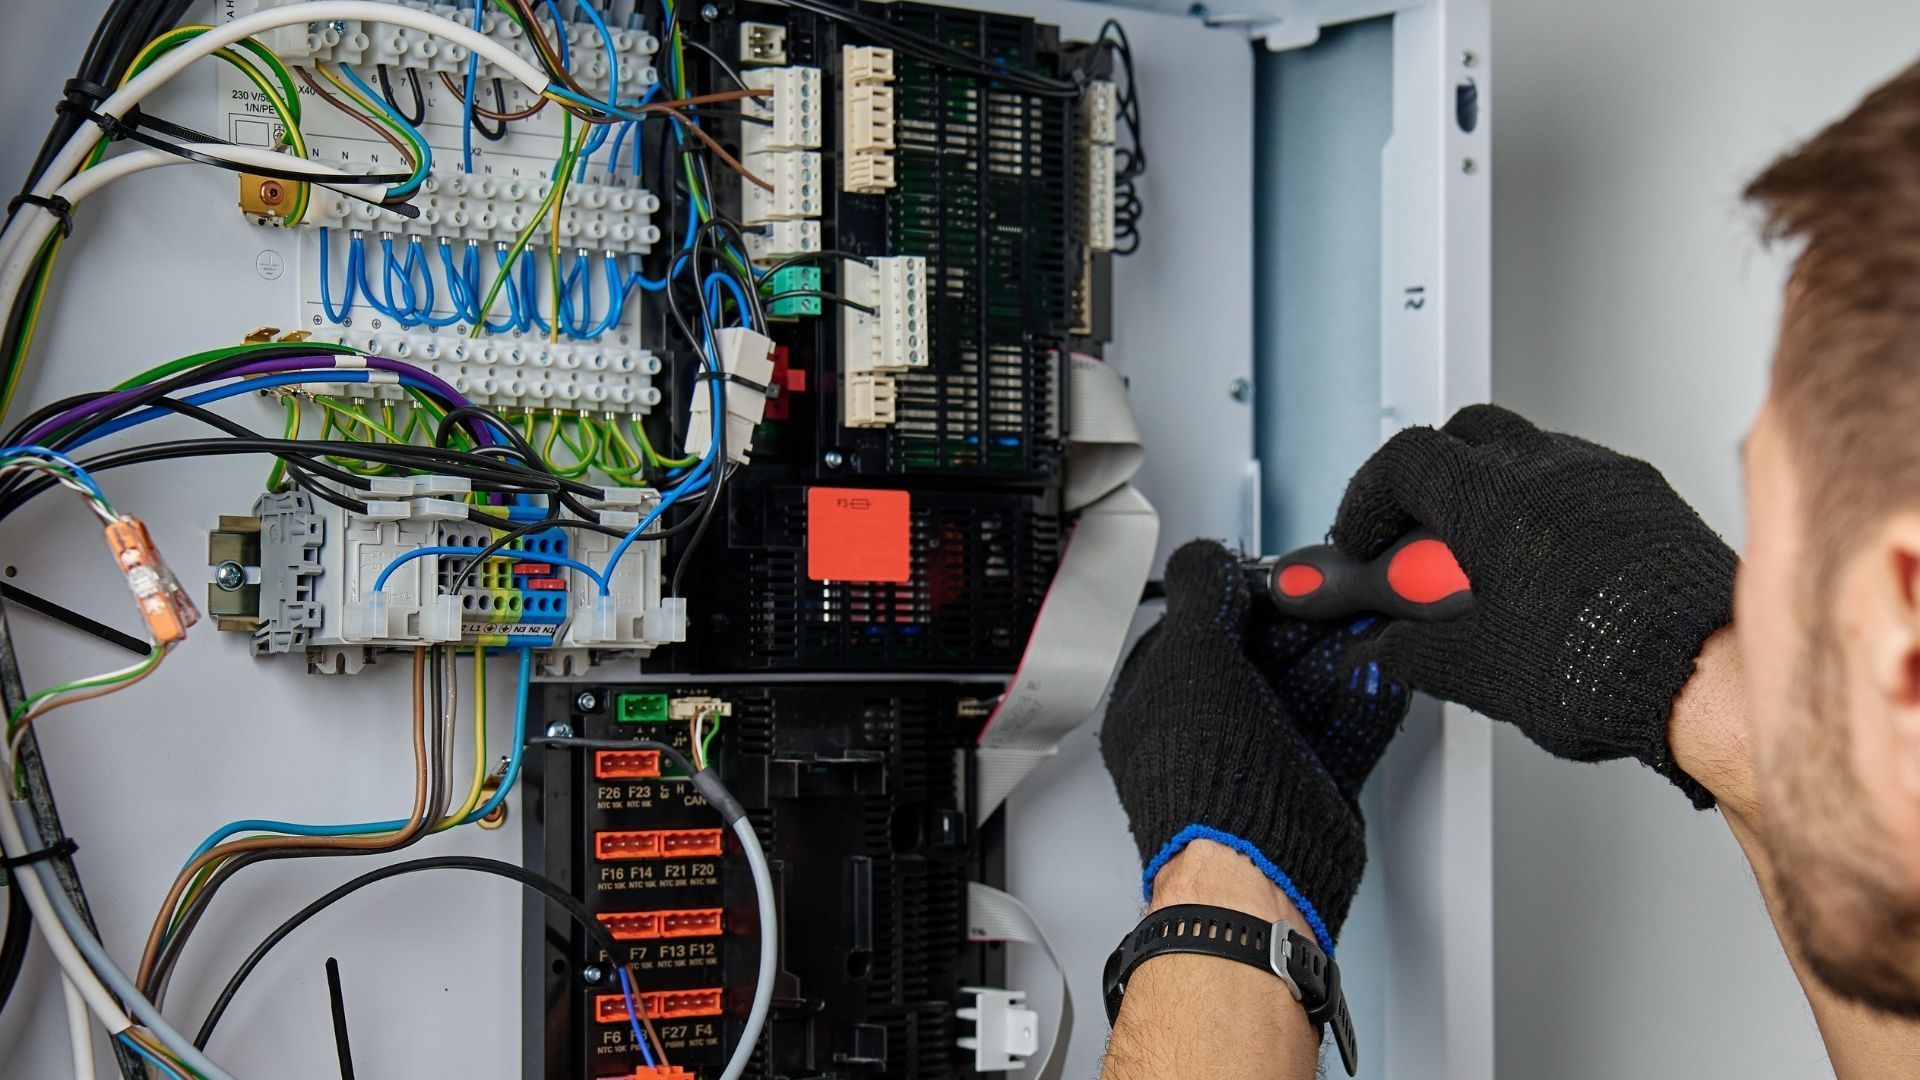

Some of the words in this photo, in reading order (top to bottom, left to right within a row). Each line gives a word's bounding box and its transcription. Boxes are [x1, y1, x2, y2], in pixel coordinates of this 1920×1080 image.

[232, 90, 249, 100] 230
[245, 103, 275, 114] 1/N/PE
[313, 148, 319, 157] N
[342, 151, 348, 159] N
[372, 155, 378, 163] N
[458, 163, 464, 171] N
[598, 787, 620, 798] F26
[628, 786, 651, 798] F23
[676, 784, 684, 793] H
[602, 868, 624, 880] F16
[631, 867, 653, 879] F14
[665, 865, 685, 877] F21
[692, 864, 714, 876] F20
[630, 948, 647, 959] F7
[660, 946, 685, 957] F13
[690, 944, 715, 955] F12
[604, 1032, 621, 1044] F6
[662, 1026, 687, 1038] F27
[695, 1024, 713, 1036] F4
